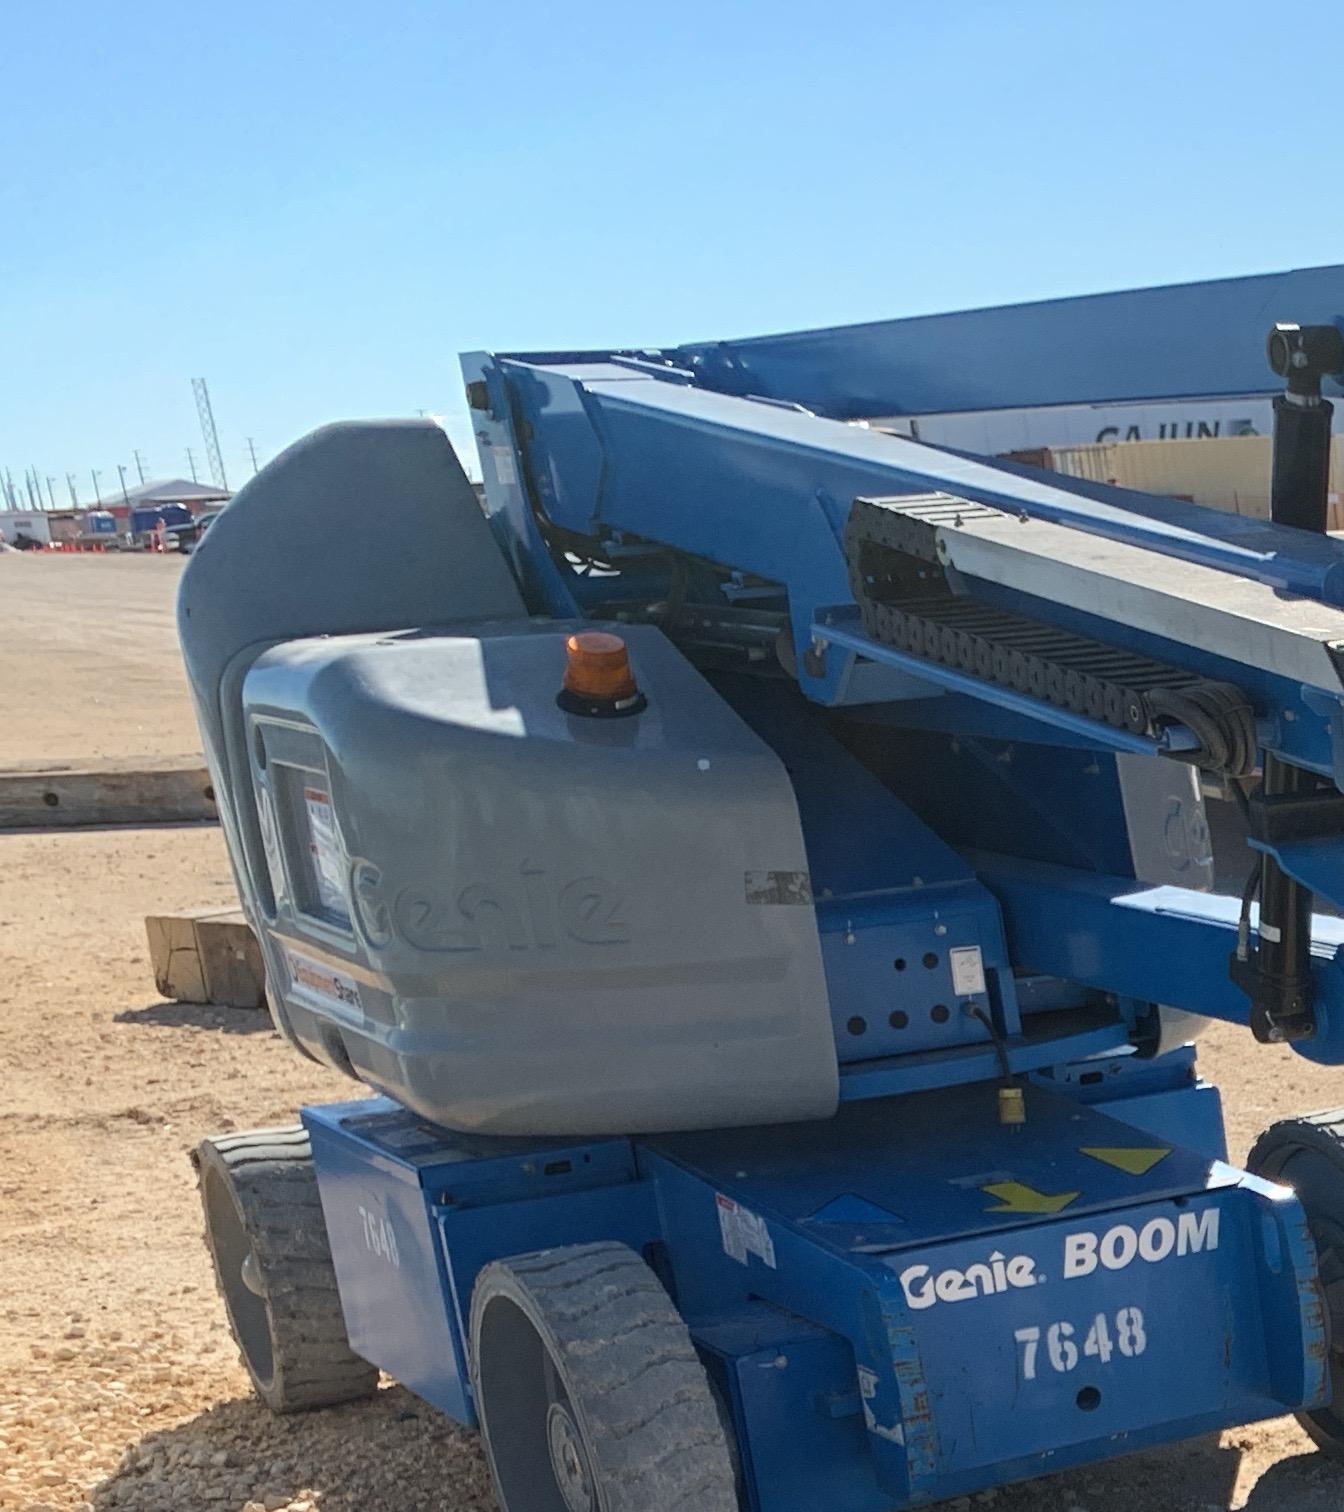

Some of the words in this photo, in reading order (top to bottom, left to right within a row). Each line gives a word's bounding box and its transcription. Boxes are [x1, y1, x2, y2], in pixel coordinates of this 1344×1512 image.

[900, 1250, 1038, 1310] Genie
[1063, 1208, 1221, 1279] BOOM
[1014, 1306, 1147, 1381] 7648
